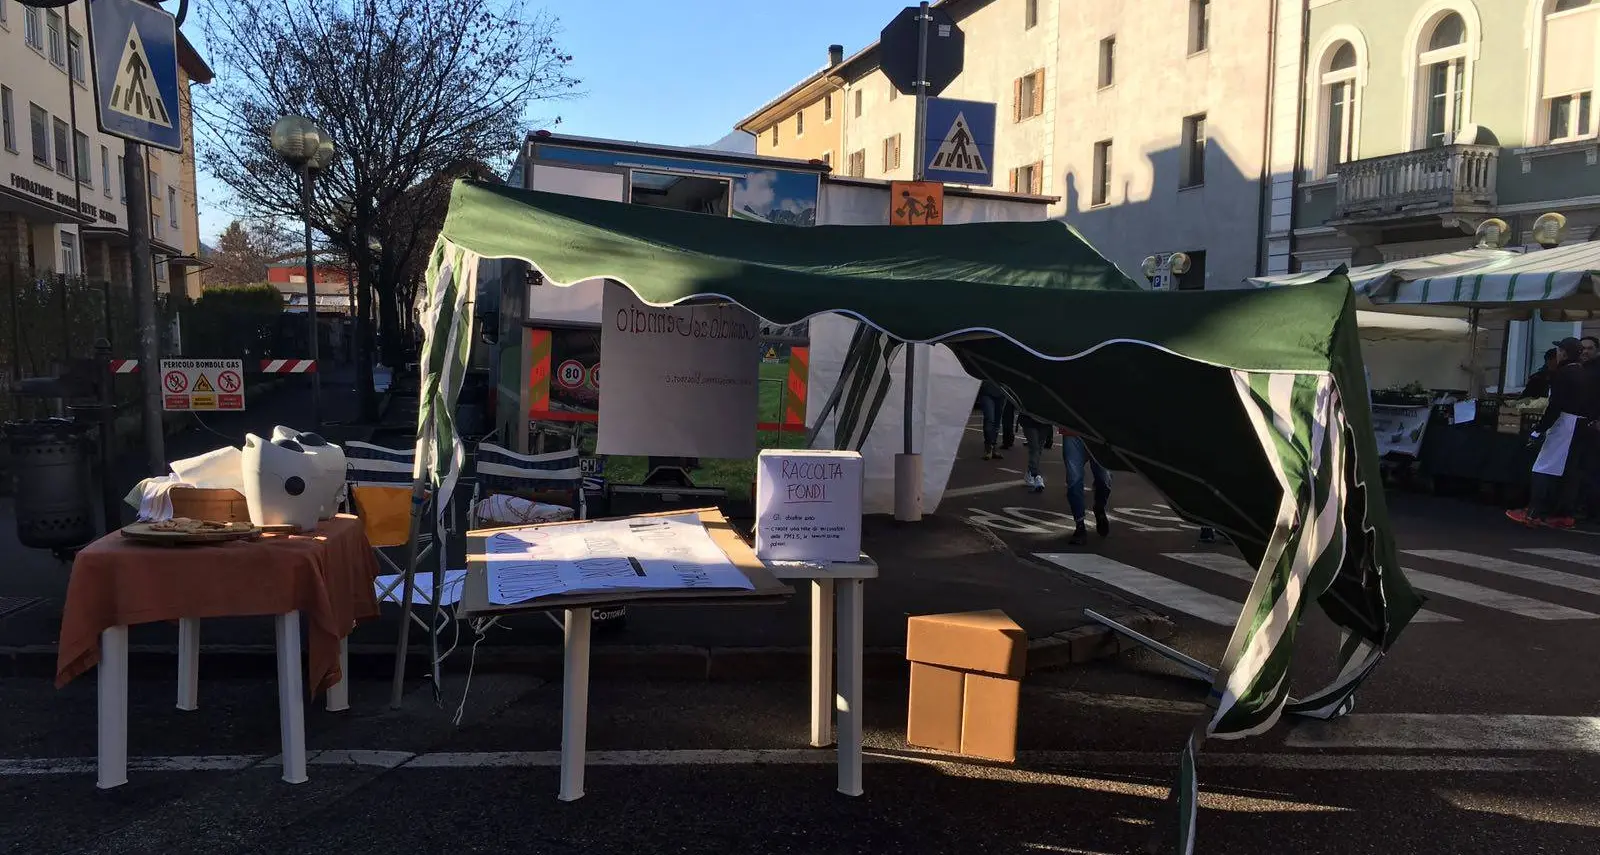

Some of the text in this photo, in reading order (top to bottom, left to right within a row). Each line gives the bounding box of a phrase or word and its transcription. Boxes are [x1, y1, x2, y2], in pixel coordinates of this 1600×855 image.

[10, 173, 54, 200] FONDAZIONE
[565, 367, 579, 379] 80
[782, 459, 843, 480] RACCOLTA
[787, 484, 826, 500] FONDI
